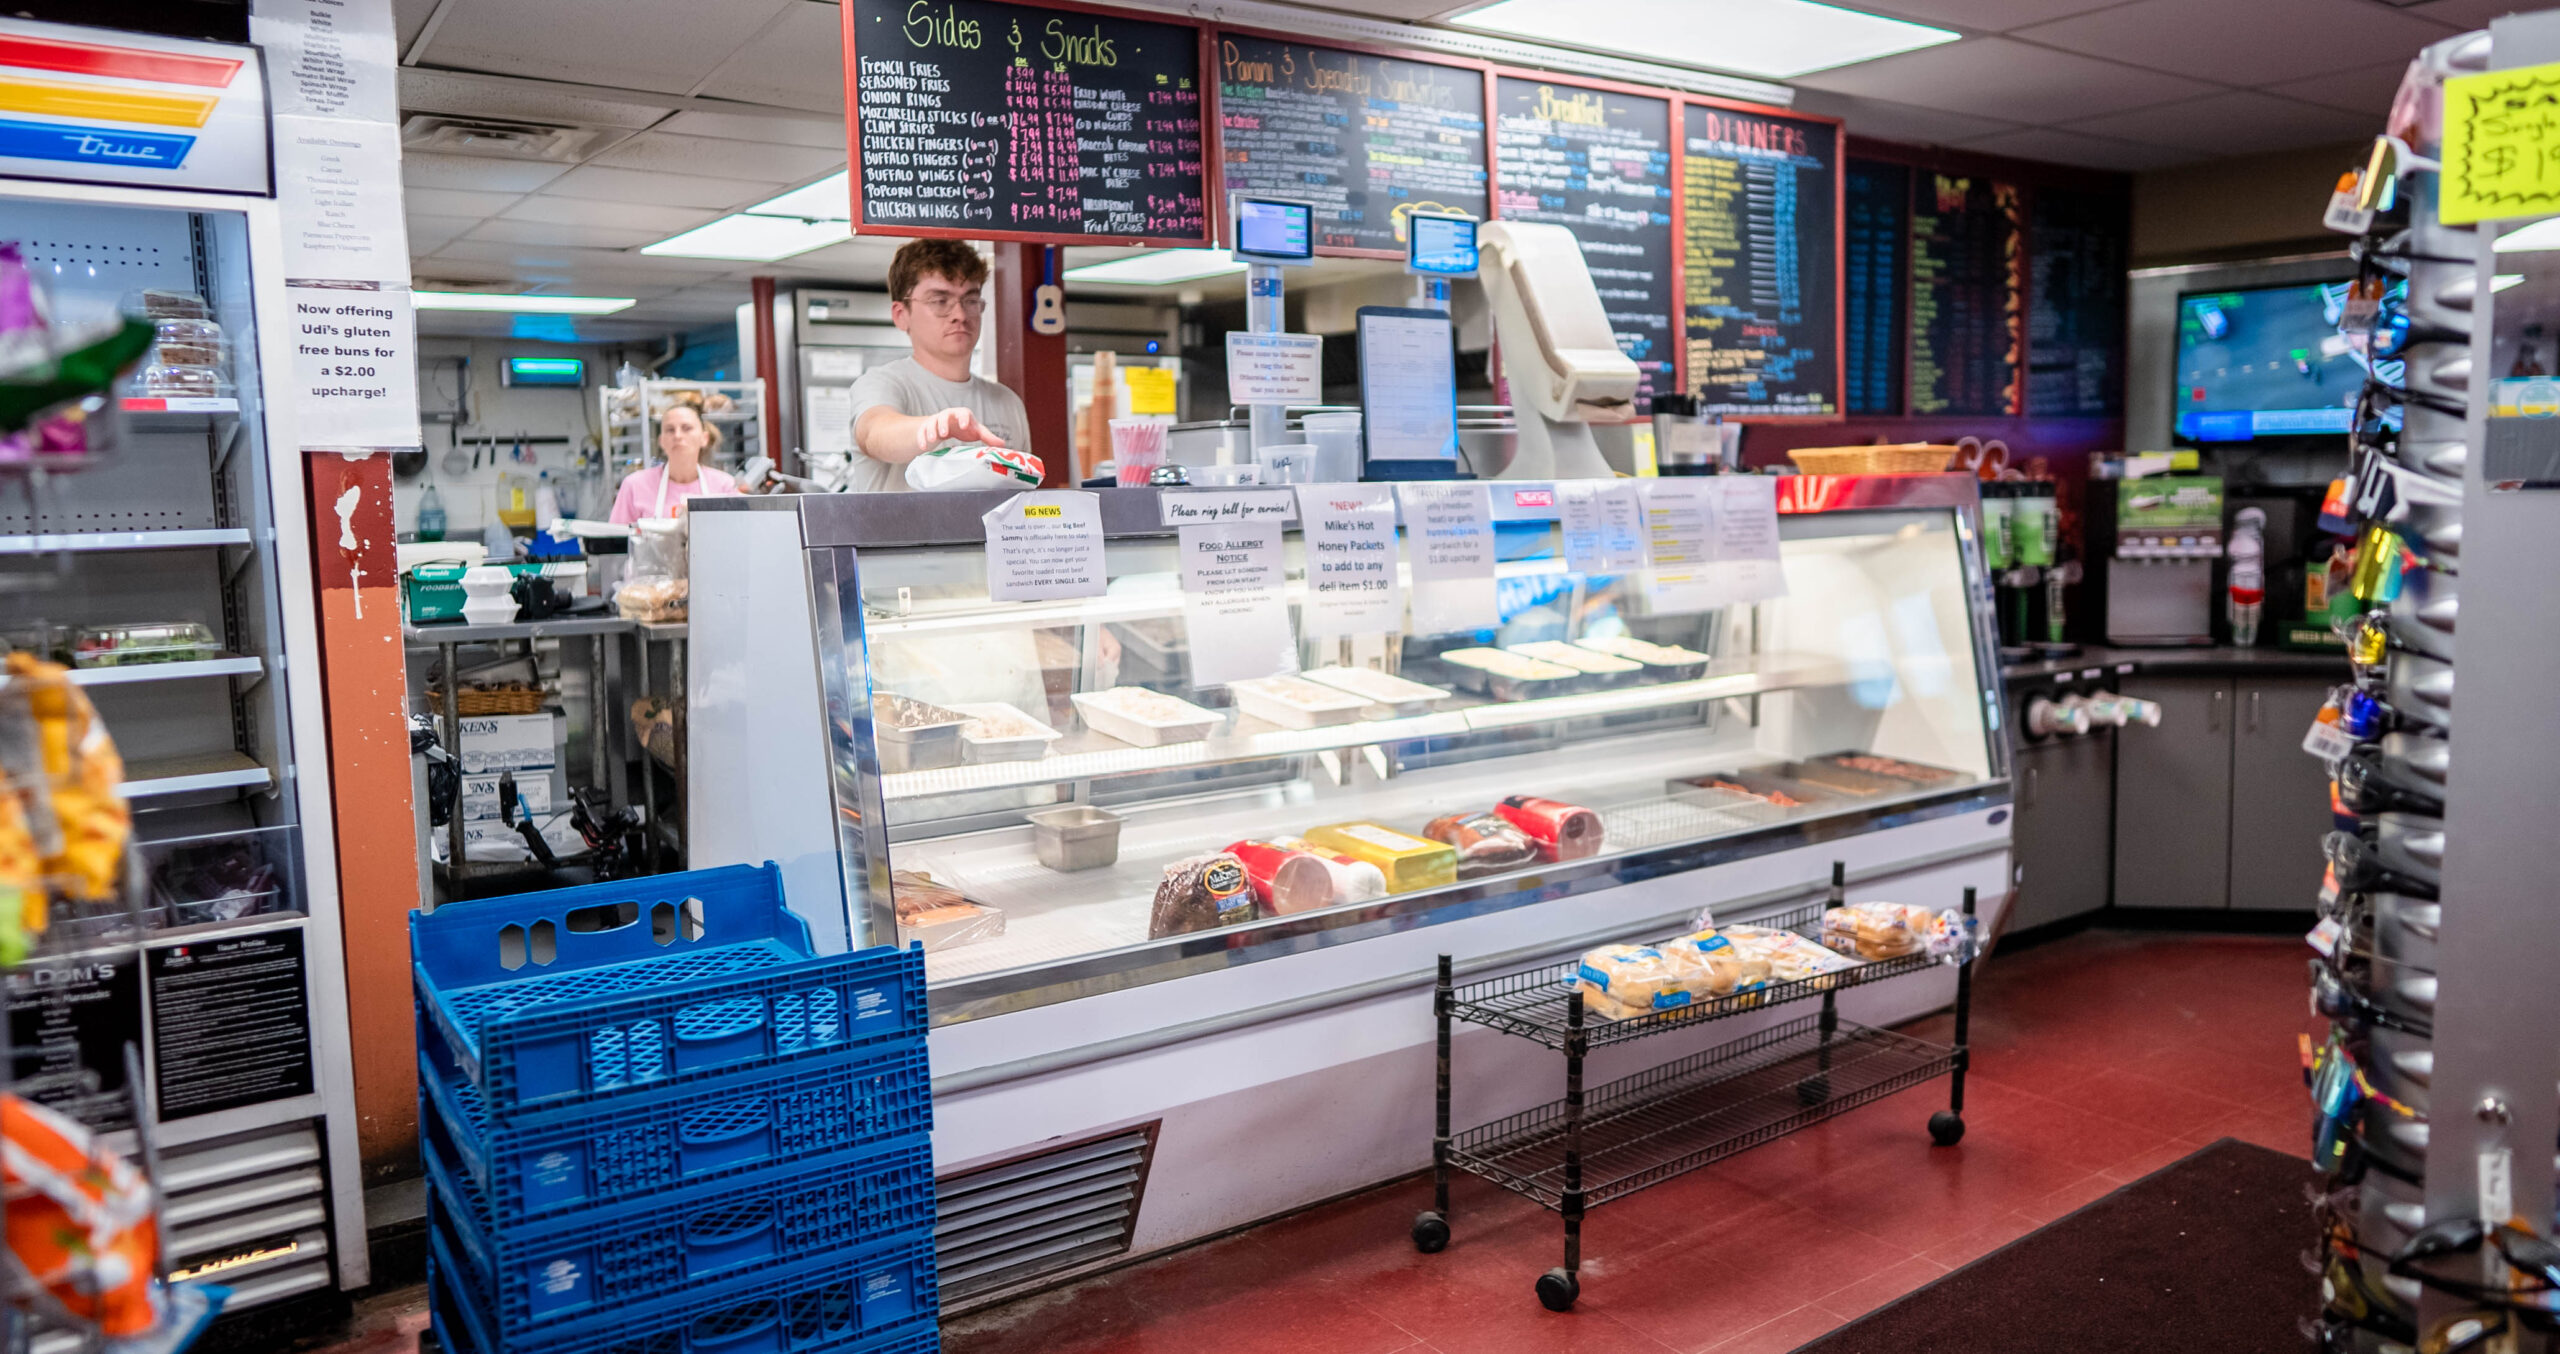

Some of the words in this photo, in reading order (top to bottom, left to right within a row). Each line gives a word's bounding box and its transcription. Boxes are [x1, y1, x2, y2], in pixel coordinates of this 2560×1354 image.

[310, 10, 332, 18] Bulkie
[310, 18, 332, 26] White
[903, 0, 982, 49] Sides
[1040, 18, 1118, 67] Snacks
[325, 59, 344, 67] Wrap
[1223, 40, 1274, 83] Panini
[302, 64, 325, 73] Wheat
[326, 67, 345, 75] Wrap
[910, 61, 941, 78] FRIES
[290, 70, 319, 79] Tomato
[320, 74, 336, 82] Basil
[338, 76, 357, 85] Wrap
[859, 76, 918, 92] SEASONED
[921, 79, 951, 92] FRIES
[300, 80, 327, 89] Spinach
[328, 82, 348, 91] Wrap
[861, 91, 901, 105] ONION
[906, 92, 942, 108] RINGS
[859, 106, 925, 123] MOZZARELLA
[927, 111, 968, 124] STICKS
[865, 120, 896, 134] CLAM
[899, 121, 936, 136] STRIPS
[1706, 112, 1807, 156] DINNERS
[62, 135, 163, 160] true
[864, 137, 915, 150] CHICKEN
[918, 137, 964, 152] FINGERS
[864, 151, 911, 166] BUFFALO
[912, 153, 959, 166] FINGERS
[865, 167, 914, 182] BUFFALO
[918, 168, 955, 183] WINGS
[865, 183, 913, 199] POPCORN
[916, 185, 961, 199] CHICKEN
[868, 199, 917, 219] CHICKEN
[918, 204, 960, 219] WINGS
[297, 303, 331, 314] Now
[336, 305, 393, 320] offering
[302, 324, 339, 335] Udi's
[344, 326, 391, 338] gluten
[299, 344, 329, 355] free
[335, 346, 370, 357] buns
[374, 347, 395, 357] for
[335, 366, 376, 377] $2.00
[312, 387, 387, 399] upcharge!
[1038, 507, 1061, 516] NEWS
[1170, 504, 1198, 517] Please
[1202, 506, 1218, 520] ring
[1222, 502, 1240, 515] bell
[1241, 502, 1254, 519] for
[1257, 500, 1290, 513] service!
[1325, 521, 1355, 531] Mike's
[1358, 521, 1375, 531] Hot
[1056, 546, 1073, 554] longer
[1199, 542, 1223, 552] FOOD
[1226, 540, 1264, 551] ALLERGY
[1318, 542, 1348, 552] Honey
[1350, 541, 1385, 551] Packets
[1216, 554, 1248, 564] NOTICE
[1197, 569, 1223, 577] PLEASE
[1322, 563, 1332, 571] to
[1335, 562, 1352, 571] add
[1355, 562, 1364, 571] to
[1367, 562, 1384, 573] any
[1006, 580, 1034, 588] sandwich
[1319, 582, 1337, 592] deli
[1339, 582, 1360, 591] item
[1363, 580, 1389, 591] $1.00
[460, 720, 498, 734] KEN'S
[34, 962, 116, 985] DOM'S
